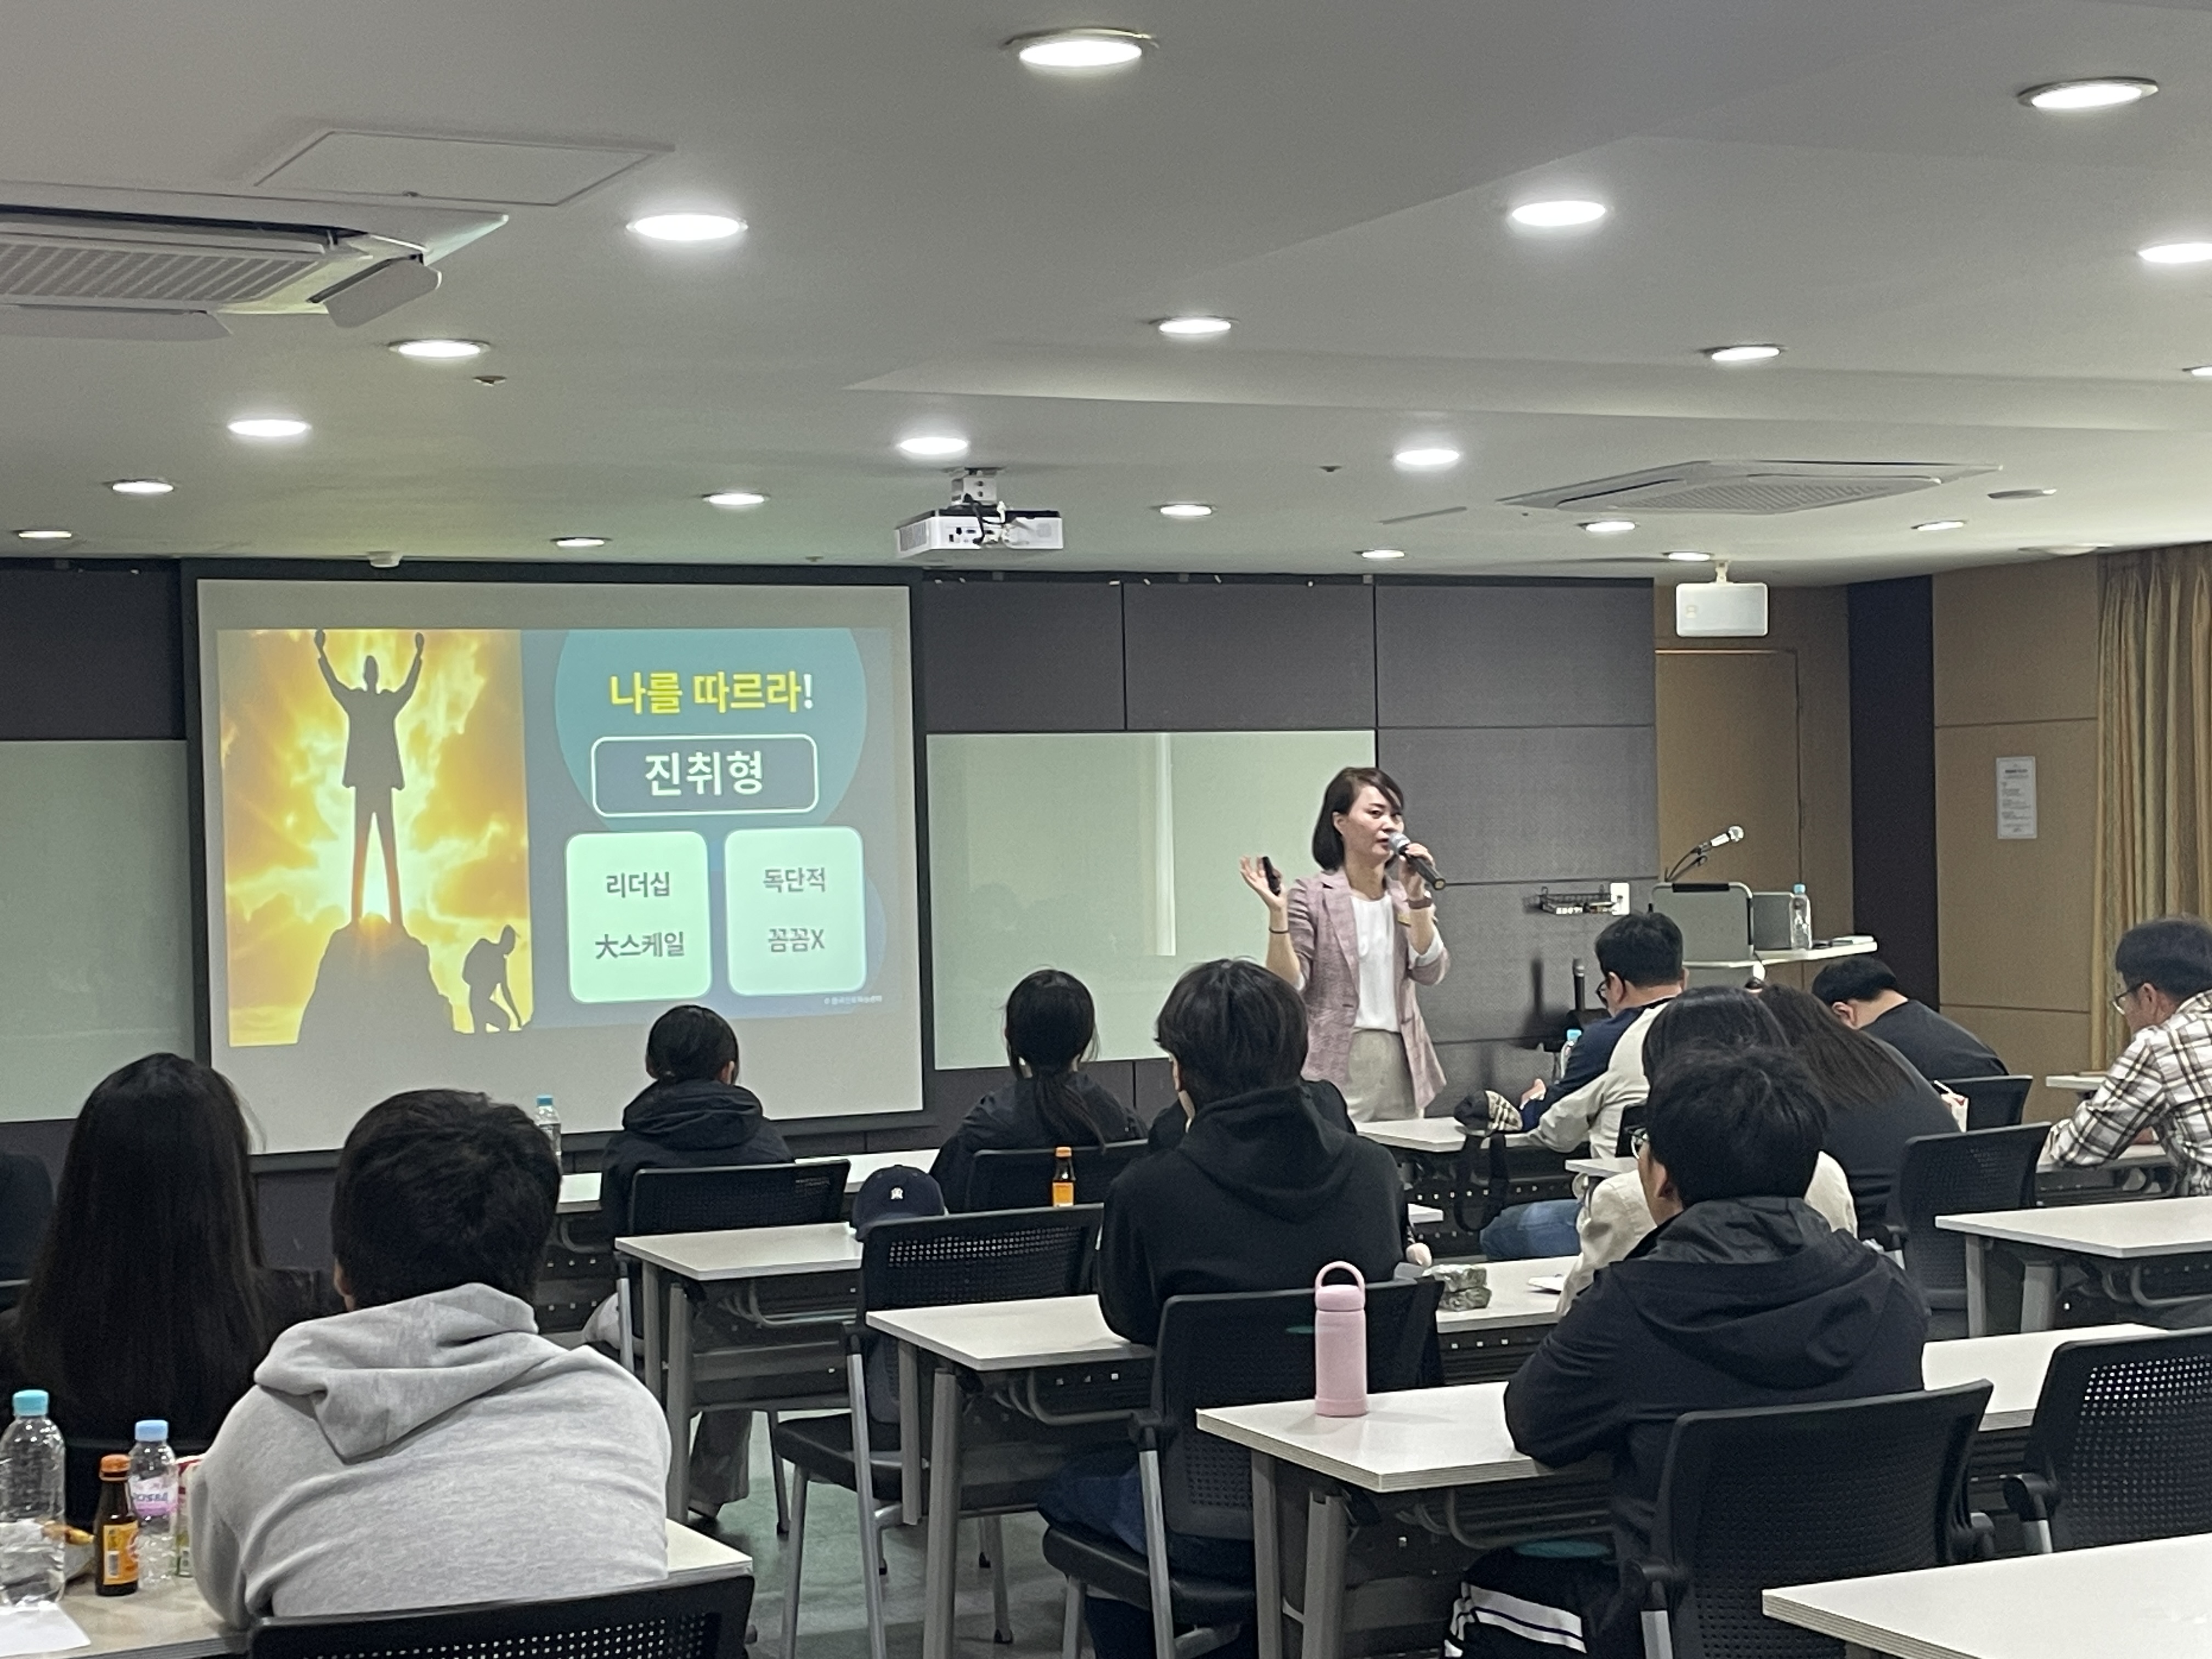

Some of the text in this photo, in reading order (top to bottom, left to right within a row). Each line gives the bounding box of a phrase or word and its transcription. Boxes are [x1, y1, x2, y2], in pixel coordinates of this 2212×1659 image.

[610, 670, 814, 715] 나를 따르라!
[645, 750, 764, 796] 진취형
[606, 872, 670, 898] 리더십
[763, 867, 827, 893] 독단적
[595, 931, 685, 960] 大스케일
[768, 928, 826, 953] 꼼꼼X
